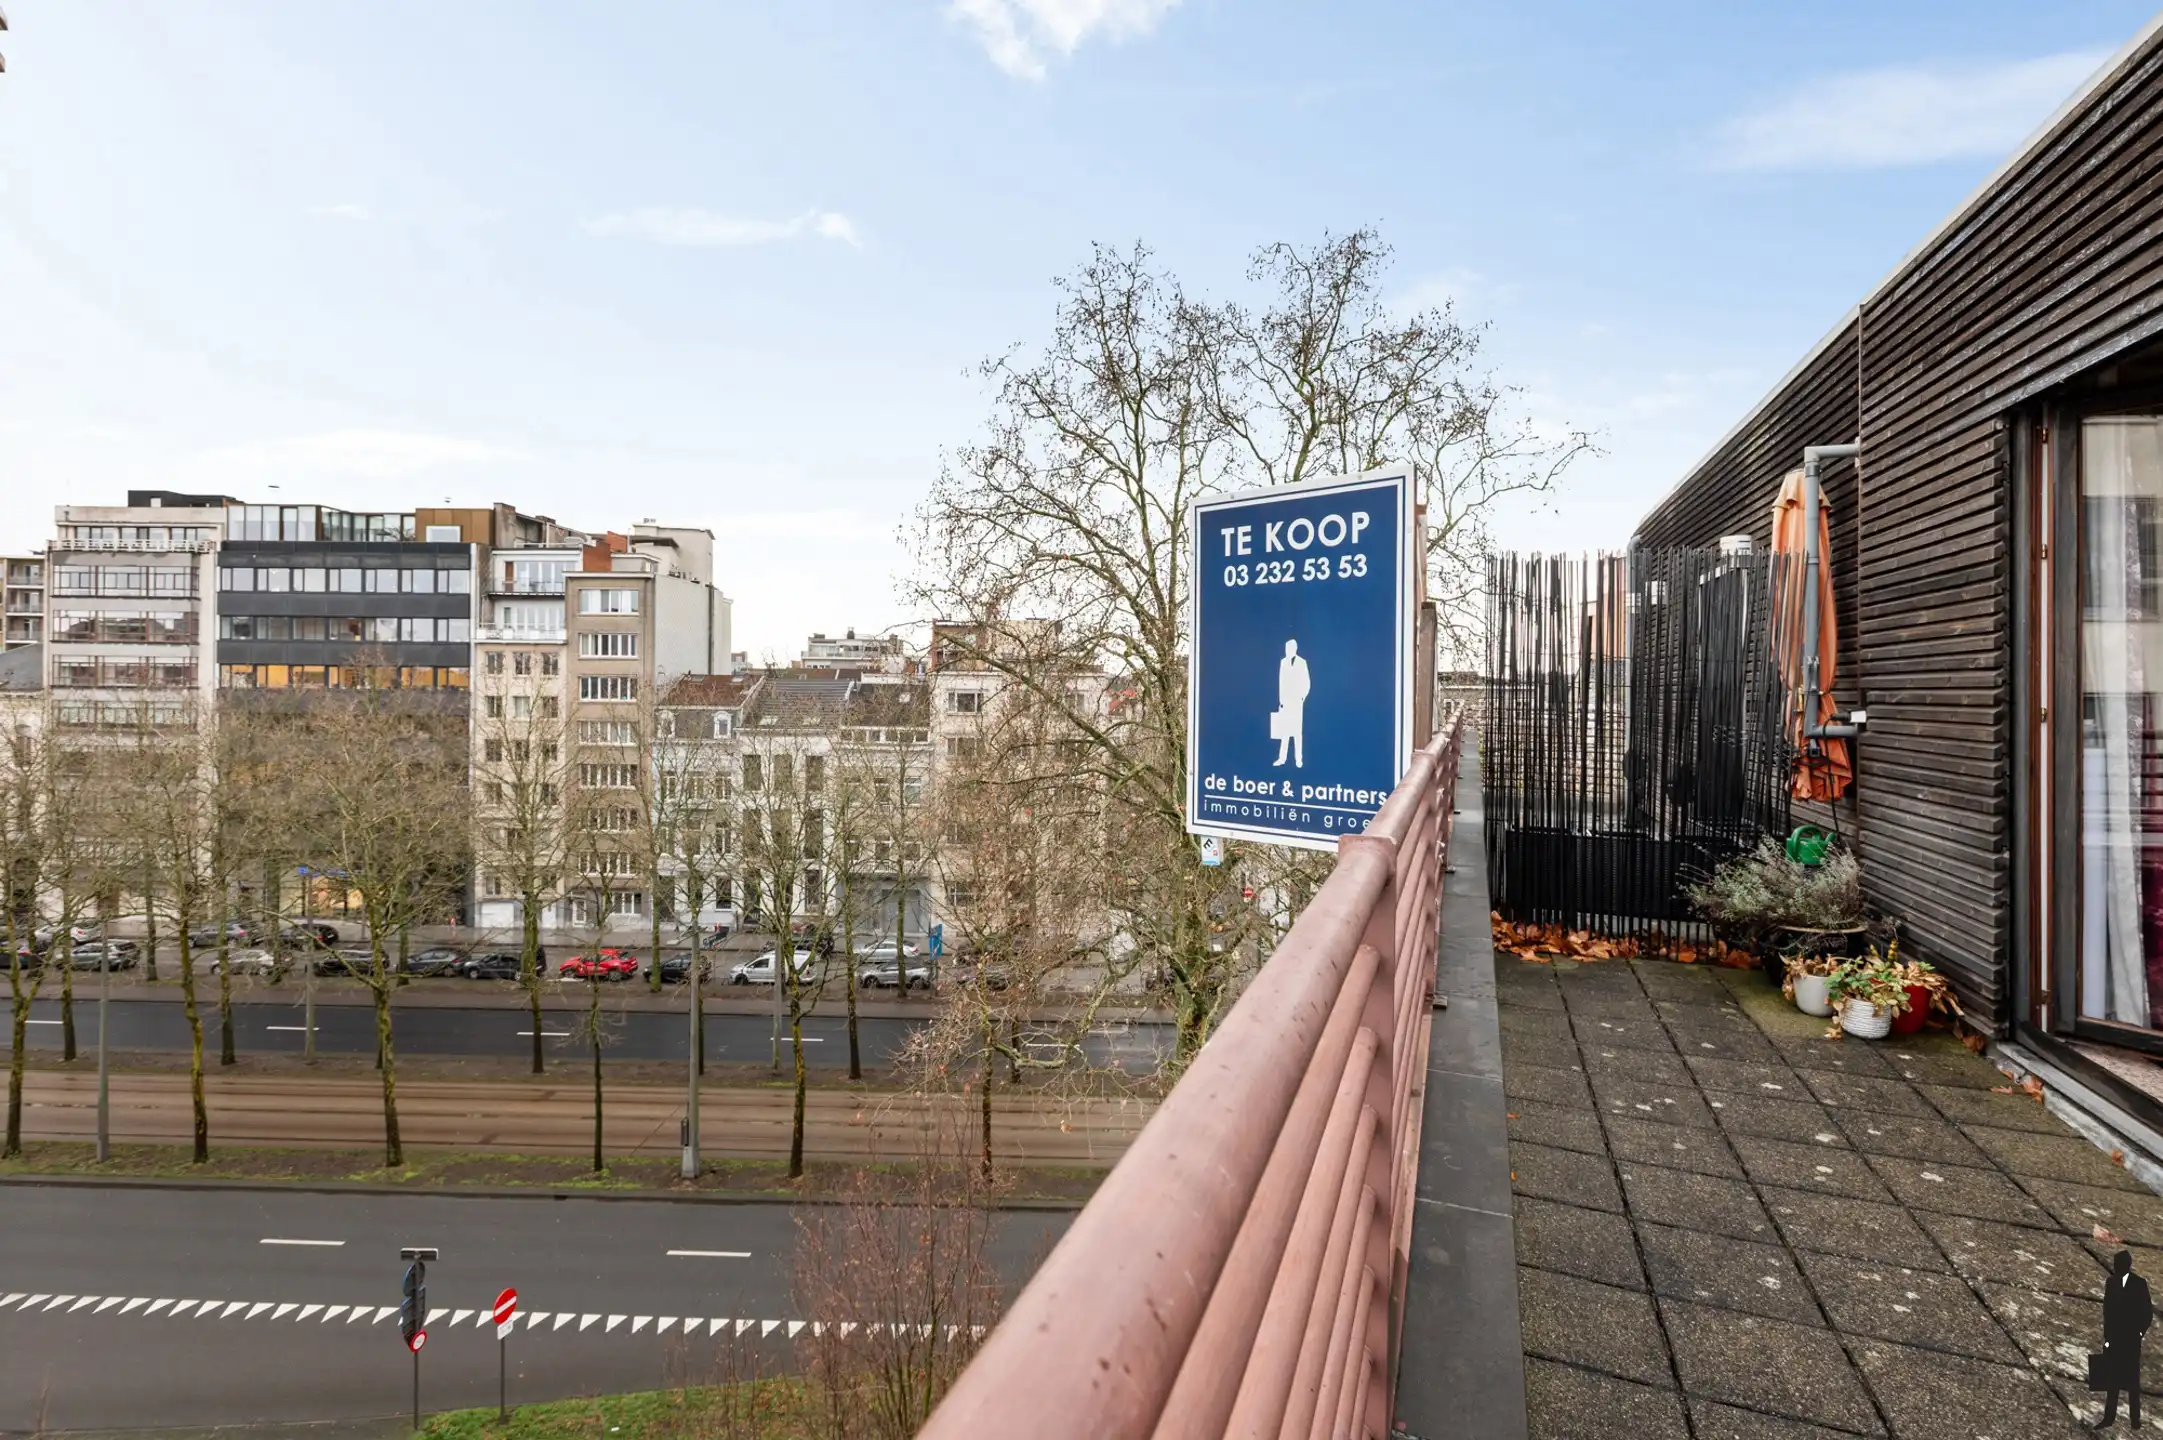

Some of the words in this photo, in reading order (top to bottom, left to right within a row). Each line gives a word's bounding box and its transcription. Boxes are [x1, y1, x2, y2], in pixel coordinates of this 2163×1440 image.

[1221, 525, 1252, 557] TE
[1265, 511, 1370, 553] KOOP
[1223, 564, 1249, 587] 03
[1255, 560, 1295, 585] 232
[1302, 556, 1331, 581] 53
[1337, 553, 1368, 579] 53
[1205, 773, 1227, 791] de
[1233, 775, 1276, 796] boer
[1282, 780, 1294, 798] &
[1302, 784, 1387, 807] partners
[1204, 799, 1311, 823] immobiliën
[1324, 815, 1373, 829] groe
